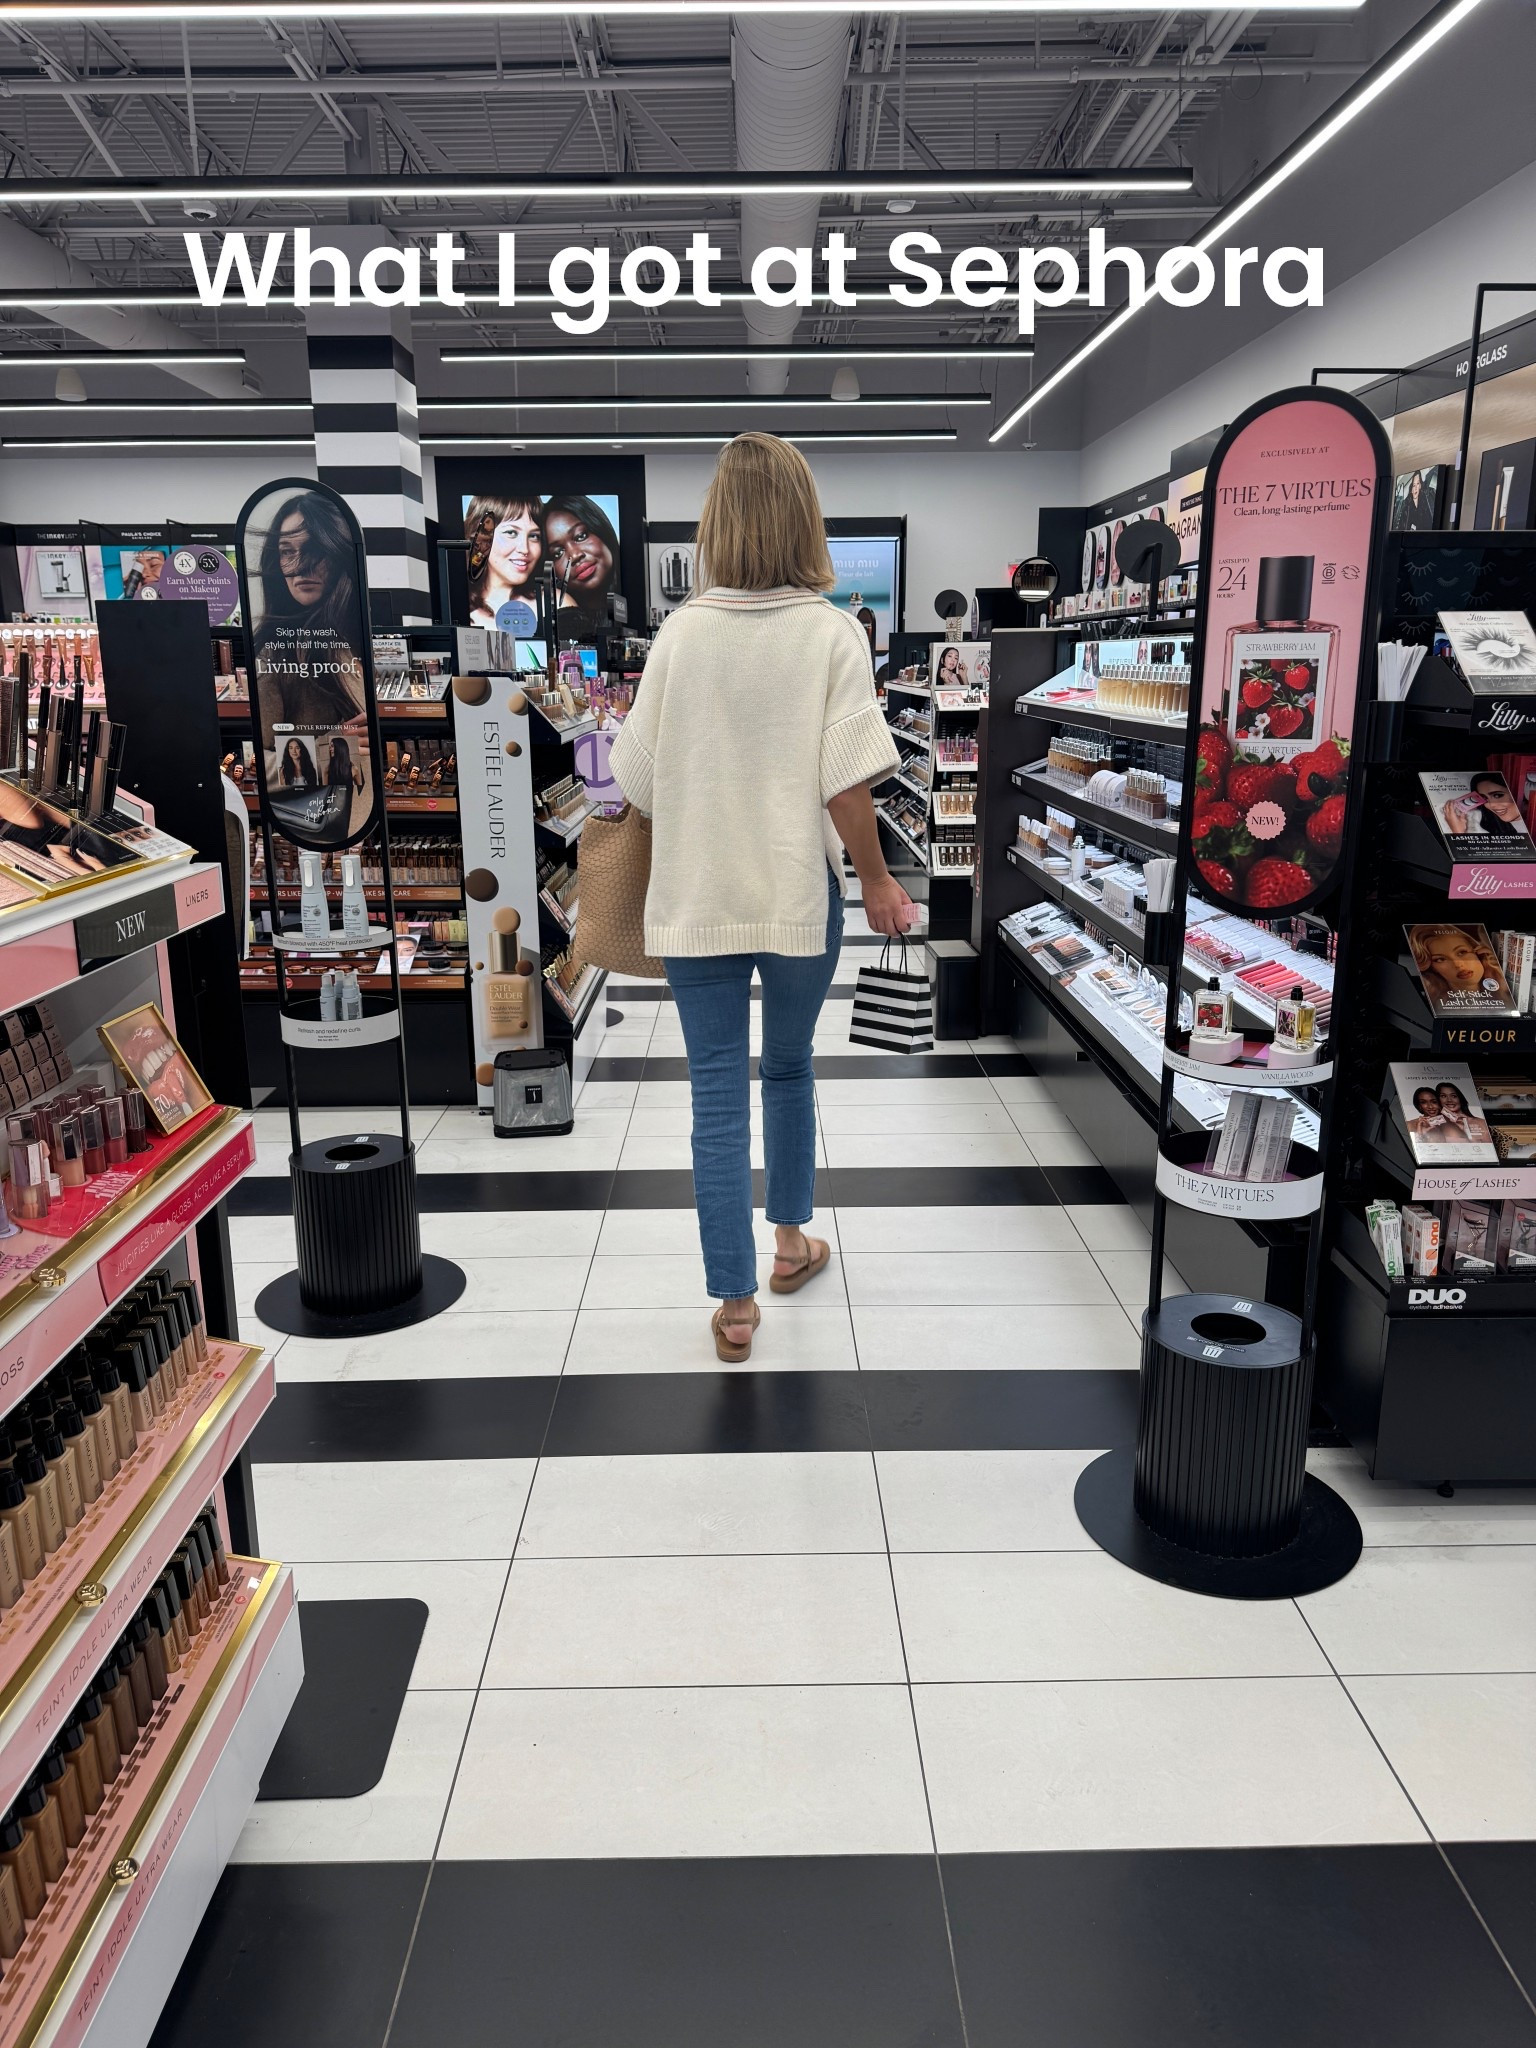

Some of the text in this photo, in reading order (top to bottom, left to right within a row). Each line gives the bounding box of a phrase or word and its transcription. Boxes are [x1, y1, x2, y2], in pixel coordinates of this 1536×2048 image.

[1456, 344, 1507, 377] HORGLASS
[1260, 448, 1317, 458] EXCLUSIVELY
[1219, 478, 1372, 504] THE 7 VIRTUES
[1234, 502, 1350, 516] Clean, long-lasting perfume
[1169, 512, 1202, 539] FRAGRAN
[179, 559, 192, 568] 4X
[202, 558, 215, 568] 5X
[1217, 566, 1248, 591] 24
[191, 586, 220, 594] Makeup
[276, 628, 338, 637] Skip the wash,
[265, 640, 351, 649] style in half the time.
[1246, 642, 1316, 652] STRAWBERRY JAM
[257, 659, 309, 678] Living
[1478, 701, 1525, 731] Lilly
[1267, 746, 1302, 756] VIRTUES
[309, 794, 336, 809] only at
[304, 806, 340, 822] Sephora
[487, 784, 506, 859] LAUDER
[1251, 816, 1279, 826] NEW!
[1457, 868, 1503, 895] Lilly
[185, 889, 209, 907] LINERS
[115, 910, 146, 942] NEW
[349, 938, 372, 946] protection
[1447, 990, 1492, 998] Self-Stick
[1447, 1030, 1516, 1042] VELOUR
[1291, 1070, 1314, 1078] WOODS
[1176, 1172, 1274, 1202] THE 7 VIRTUES
[1418, 1178, 1518, 1195] HOUSE of LASHES
[115, 1238, 150, 1277] JUICIFIES
[150, 1224, 165, 1244] LIKE
[165, 1218, 171, 1228] A
[194, 1181, 208, 1200] ACTS
[210, 1169, 221, 1187] LIKE
[222, 1166, 226, 1174] A
[227, 1148, 245, 1170] SERUM
[1431, 1222, 1439, 1246] DUO
[1408, 1288, 1466, 1304] DUO
[35, 1555, 153, 1733] TEINT IDOLE ULTRA WEAR
[77, 1807, 183, 2021] TEINT IDOLE ULTRA WEAR
